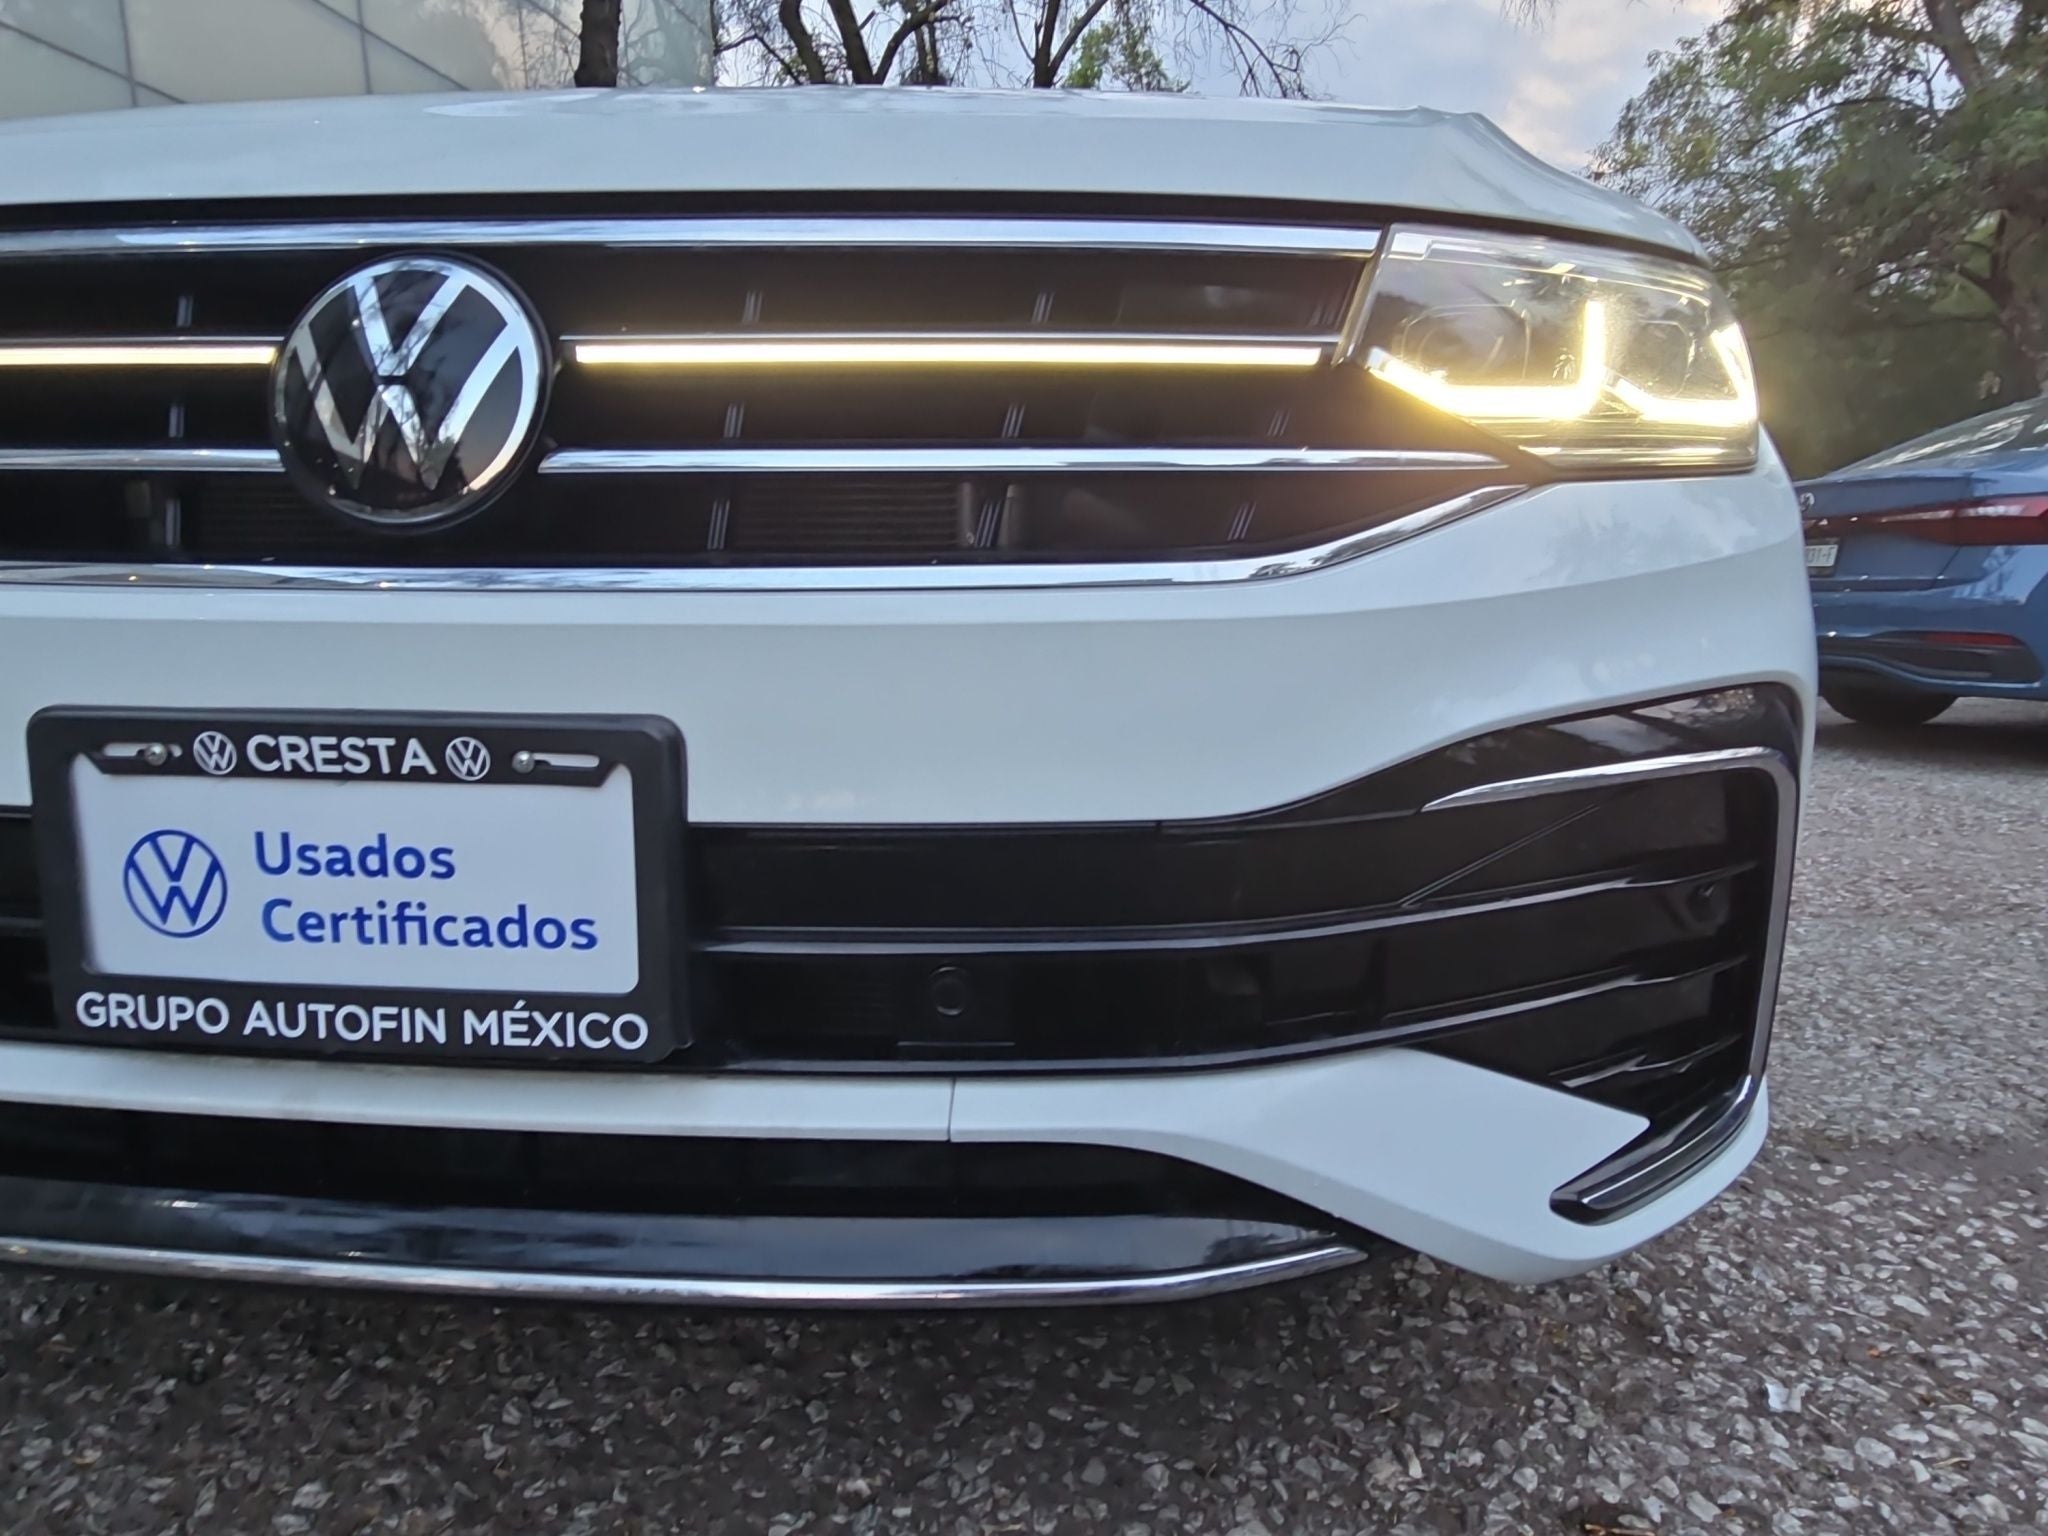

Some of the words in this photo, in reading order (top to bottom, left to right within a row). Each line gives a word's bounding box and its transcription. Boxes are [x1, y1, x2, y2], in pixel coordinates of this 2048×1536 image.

[246, 734, 437, 775] CRESTA
[254, 831, 456, 880] Usados
[262, 898, 598, 950] Certificados
[76, 991, 230, 1034] GRUPO
[243, 1000, 447, 1044] AUTOFIN
[463, 999, 649, 1050] MÉXICO
